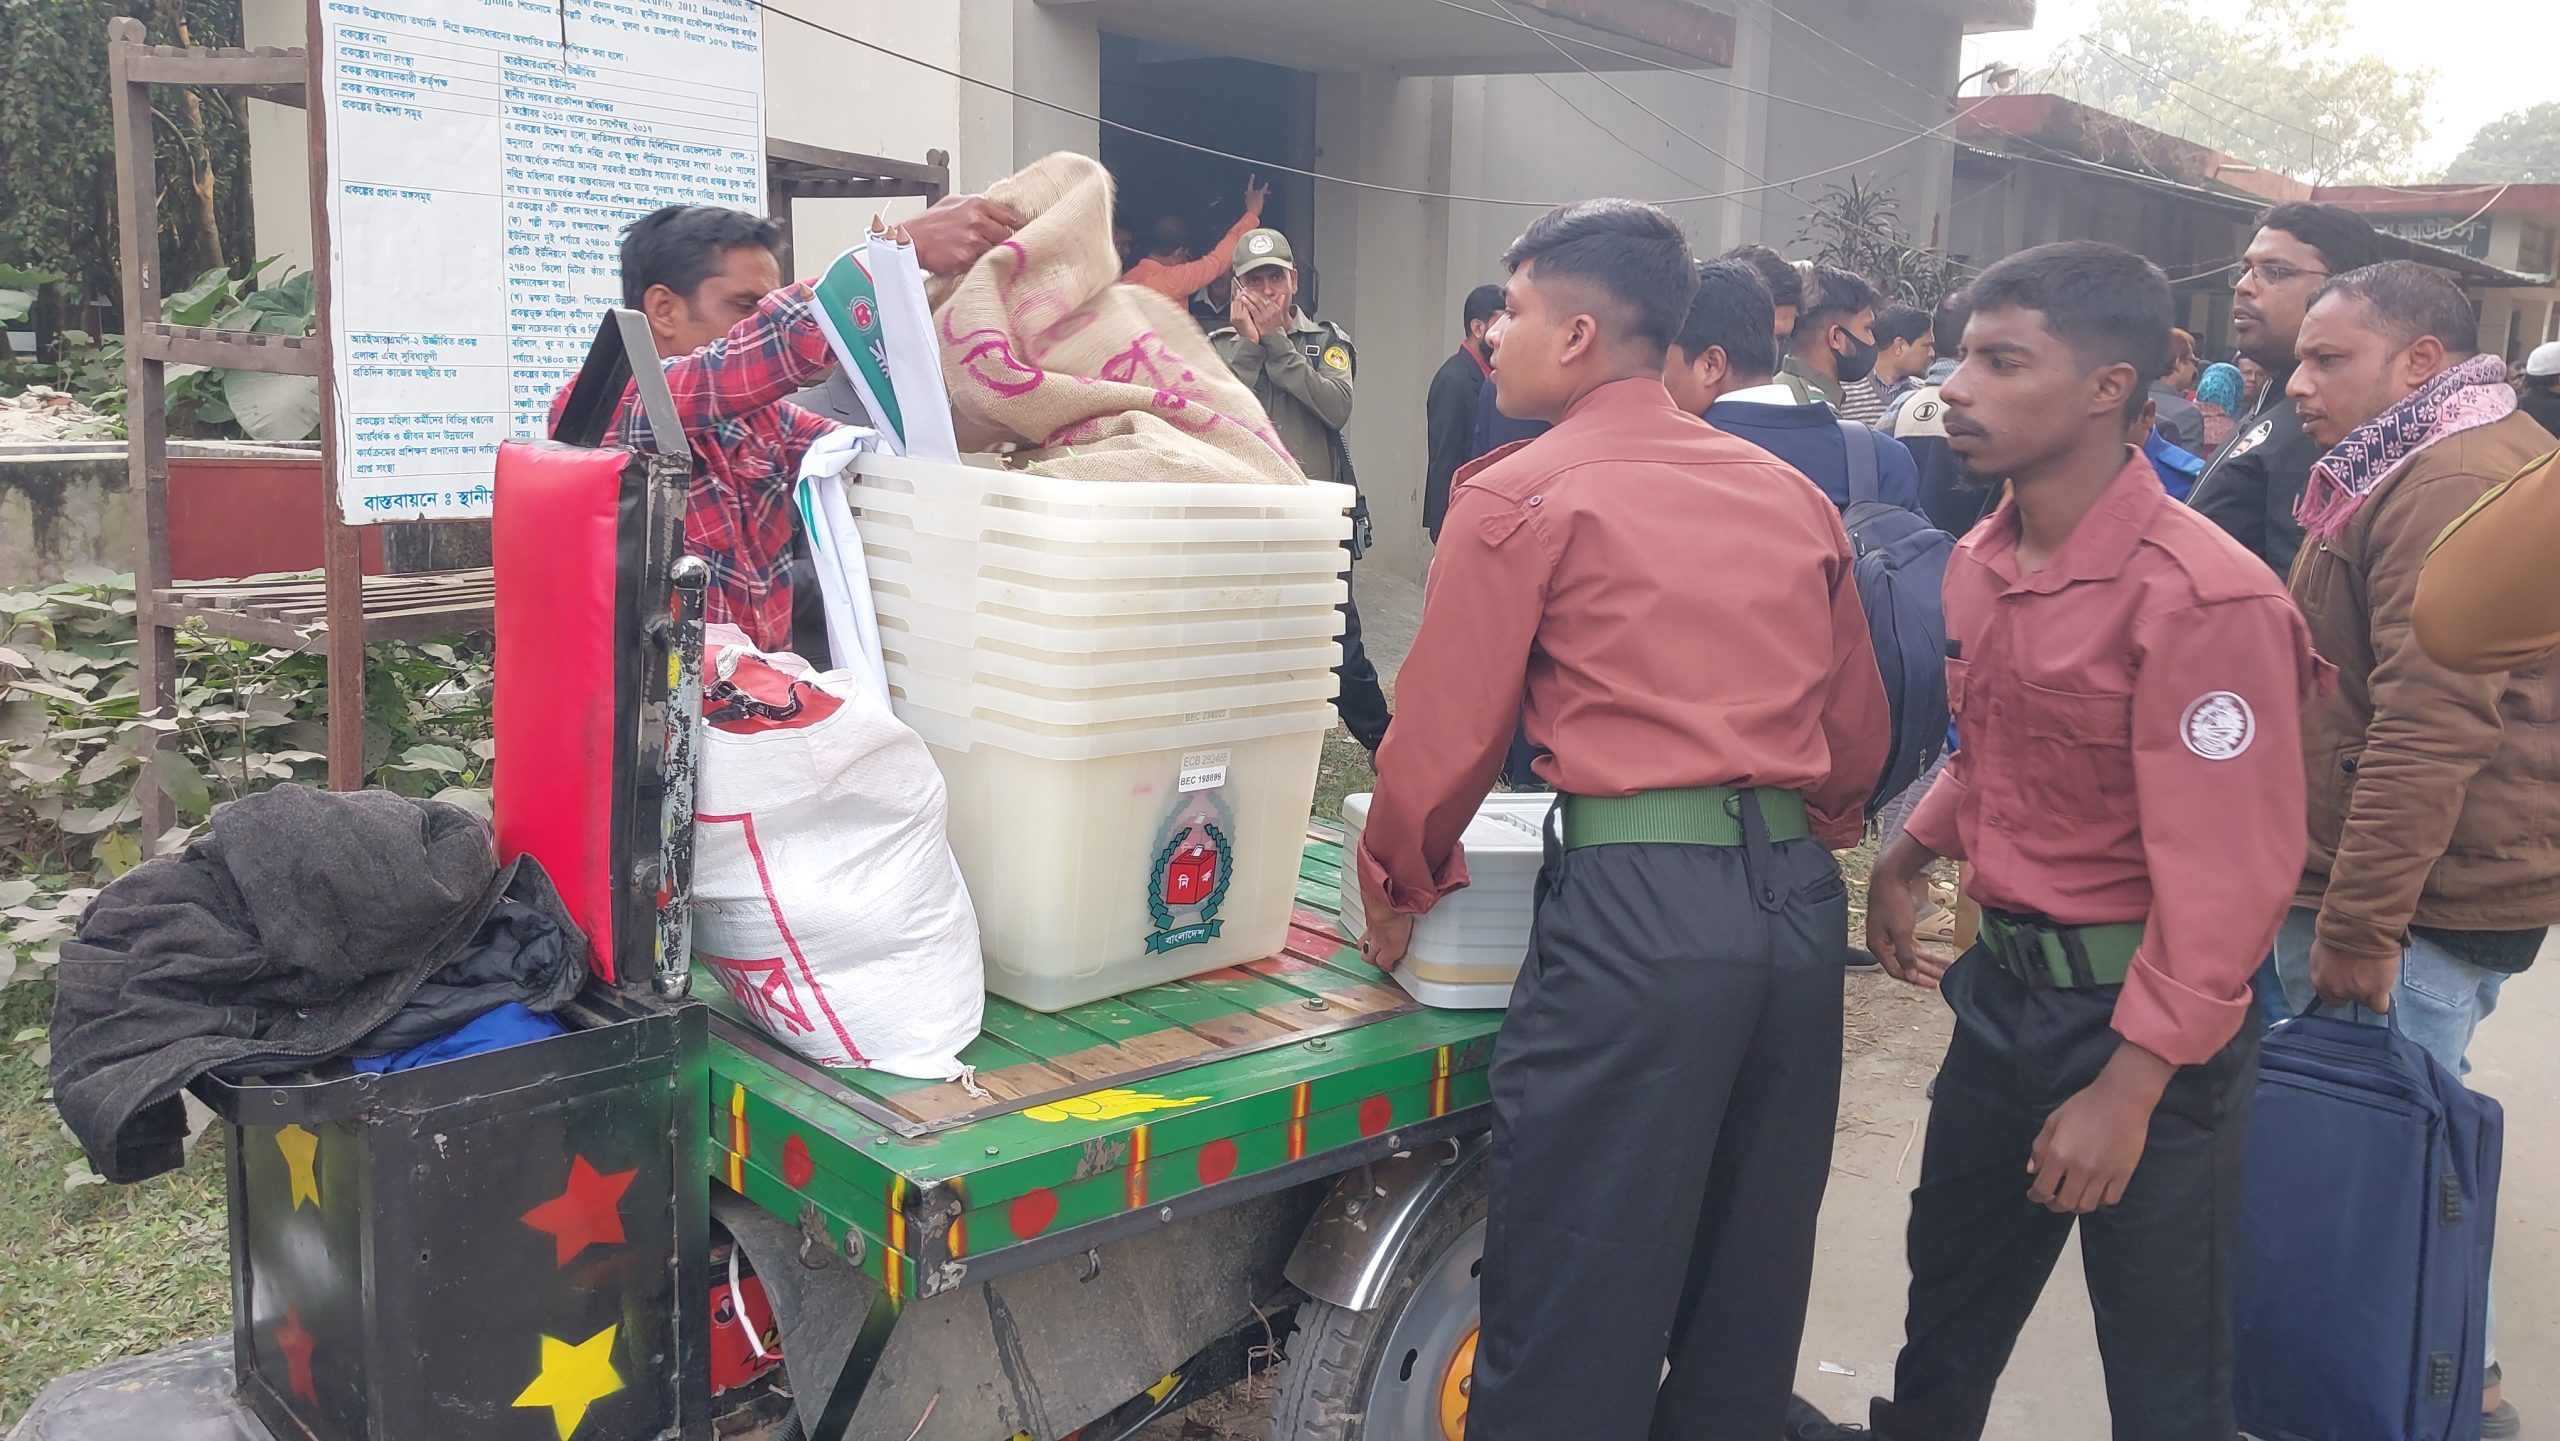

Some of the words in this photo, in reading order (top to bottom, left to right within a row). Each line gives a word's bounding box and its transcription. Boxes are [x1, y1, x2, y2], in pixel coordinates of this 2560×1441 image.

[701, 6, 748, 22] Bangladesh
[373, 34, 387, 43] নাম
[363, 493, 438, 511] বাস্তবায়নে
[1183, 755, 1201, 767] ECB
[1180, 775, 1197, 786] BEC
[1177, 873, 1190, 890] নি
[1165, 928, 1205, 945] বাংলাদেশ
